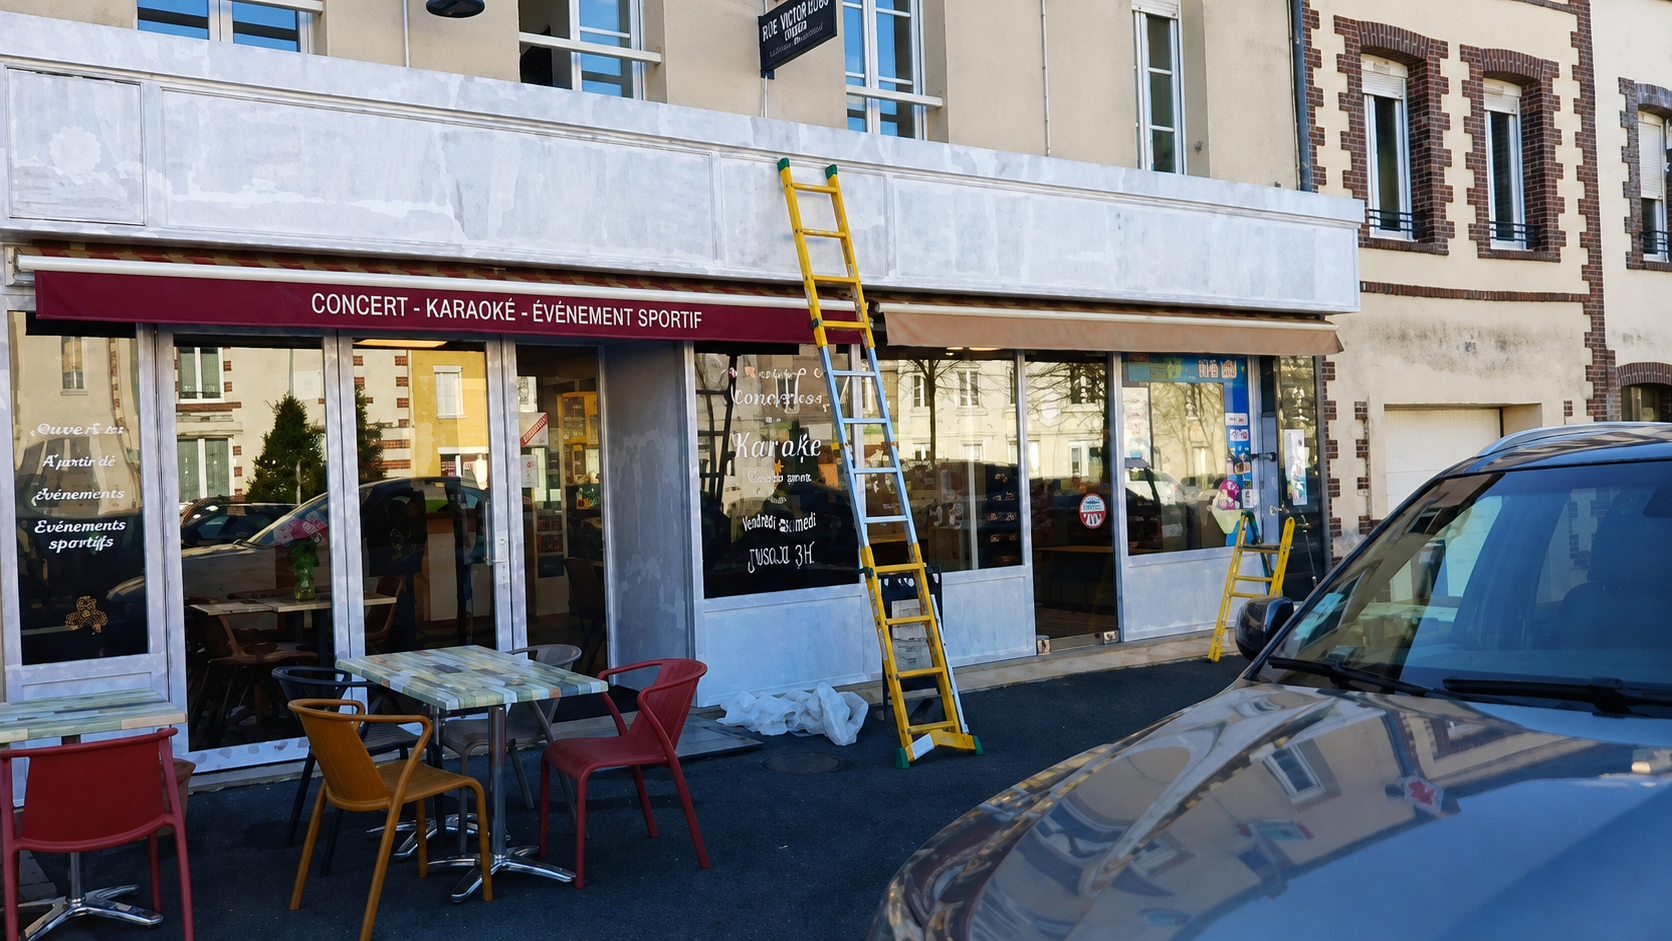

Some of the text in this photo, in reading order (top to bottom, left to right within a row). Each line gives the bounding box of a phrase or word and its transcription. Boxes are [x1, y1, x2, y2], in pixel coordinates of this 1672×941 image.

[311, 292, 409, 317] CONCERT
[426, 297, 516, 321] KARAOKÉ
[532, 299, 633, 326] ÉVÉNEMENT
[638, 308, 702, 329] SPORTIF
[34, 520, 126, 534] Evénements
